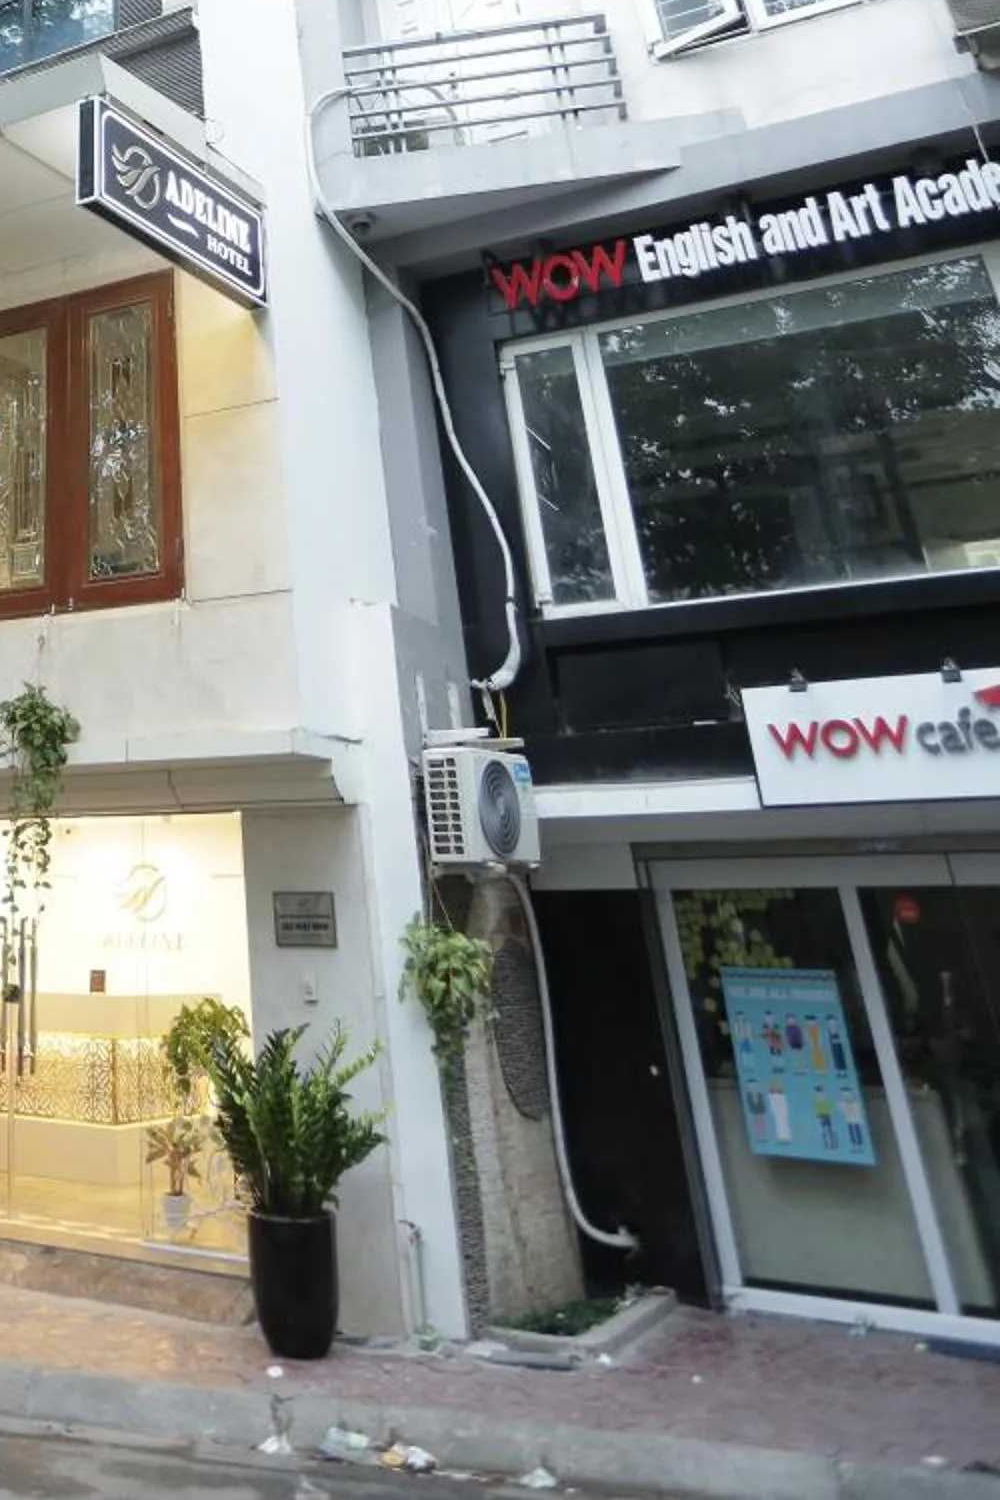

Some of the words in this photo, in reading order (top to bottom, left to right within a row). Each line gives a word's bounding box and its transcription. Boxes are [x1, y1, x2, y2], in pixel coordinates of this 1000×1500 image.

[165, 169, 252, 255] ADELINE
[206, 232, 253, 277] HOTEL
[492, 238, 627, 311] WOW
[632, 214, 757, 284] English
[758, 196, 829, 256] and
[827, 183, 892, 242] Art
[767, 714, 909, 761] WOW
